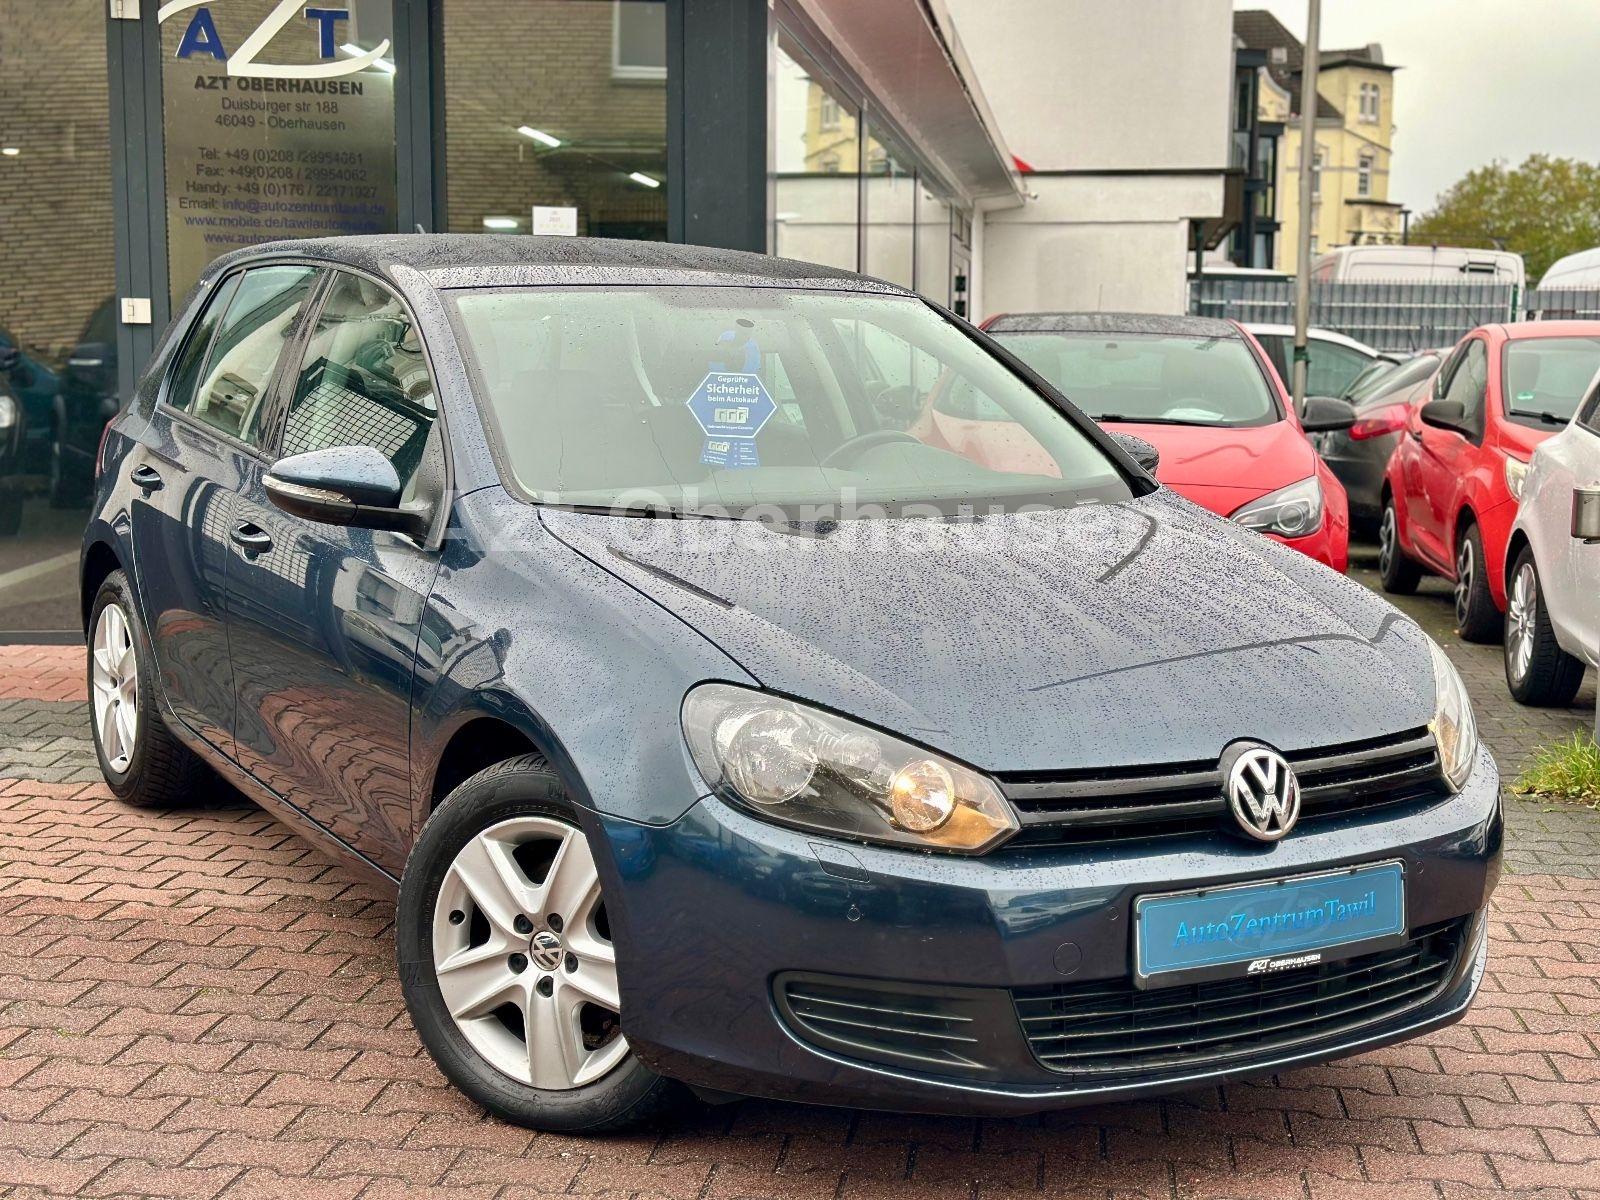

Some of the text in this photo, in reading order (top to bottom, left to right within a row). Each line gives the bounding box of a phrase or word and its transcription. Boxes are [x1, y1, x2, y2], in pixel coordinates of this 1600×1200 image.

[194, 76, 363, 95] AZT OBERHAUSEN
[221, 97, 339, 115] Duisburger str 188
[214, 114, 256, 128] 46049
[267, 115, 346, 131] Oberhausen
[198, 146, 221, 160] Tel:
[224, 148, 249, 161] +49
[253, 148, 294, 163] (0)208
[195, 163, 225, 177] Fax:
[185, 180, 231, 196] Handy:
[235, 182, 260, 195] +49
[263, 182, 304, 197] (0)176
[178, 196, 219, 209] Email:
[717, 375, 748, 384] Geprüfte
[706, 383, 760, 396] Sicherheit
[707, 395, 759, 404] beim Autokauf
